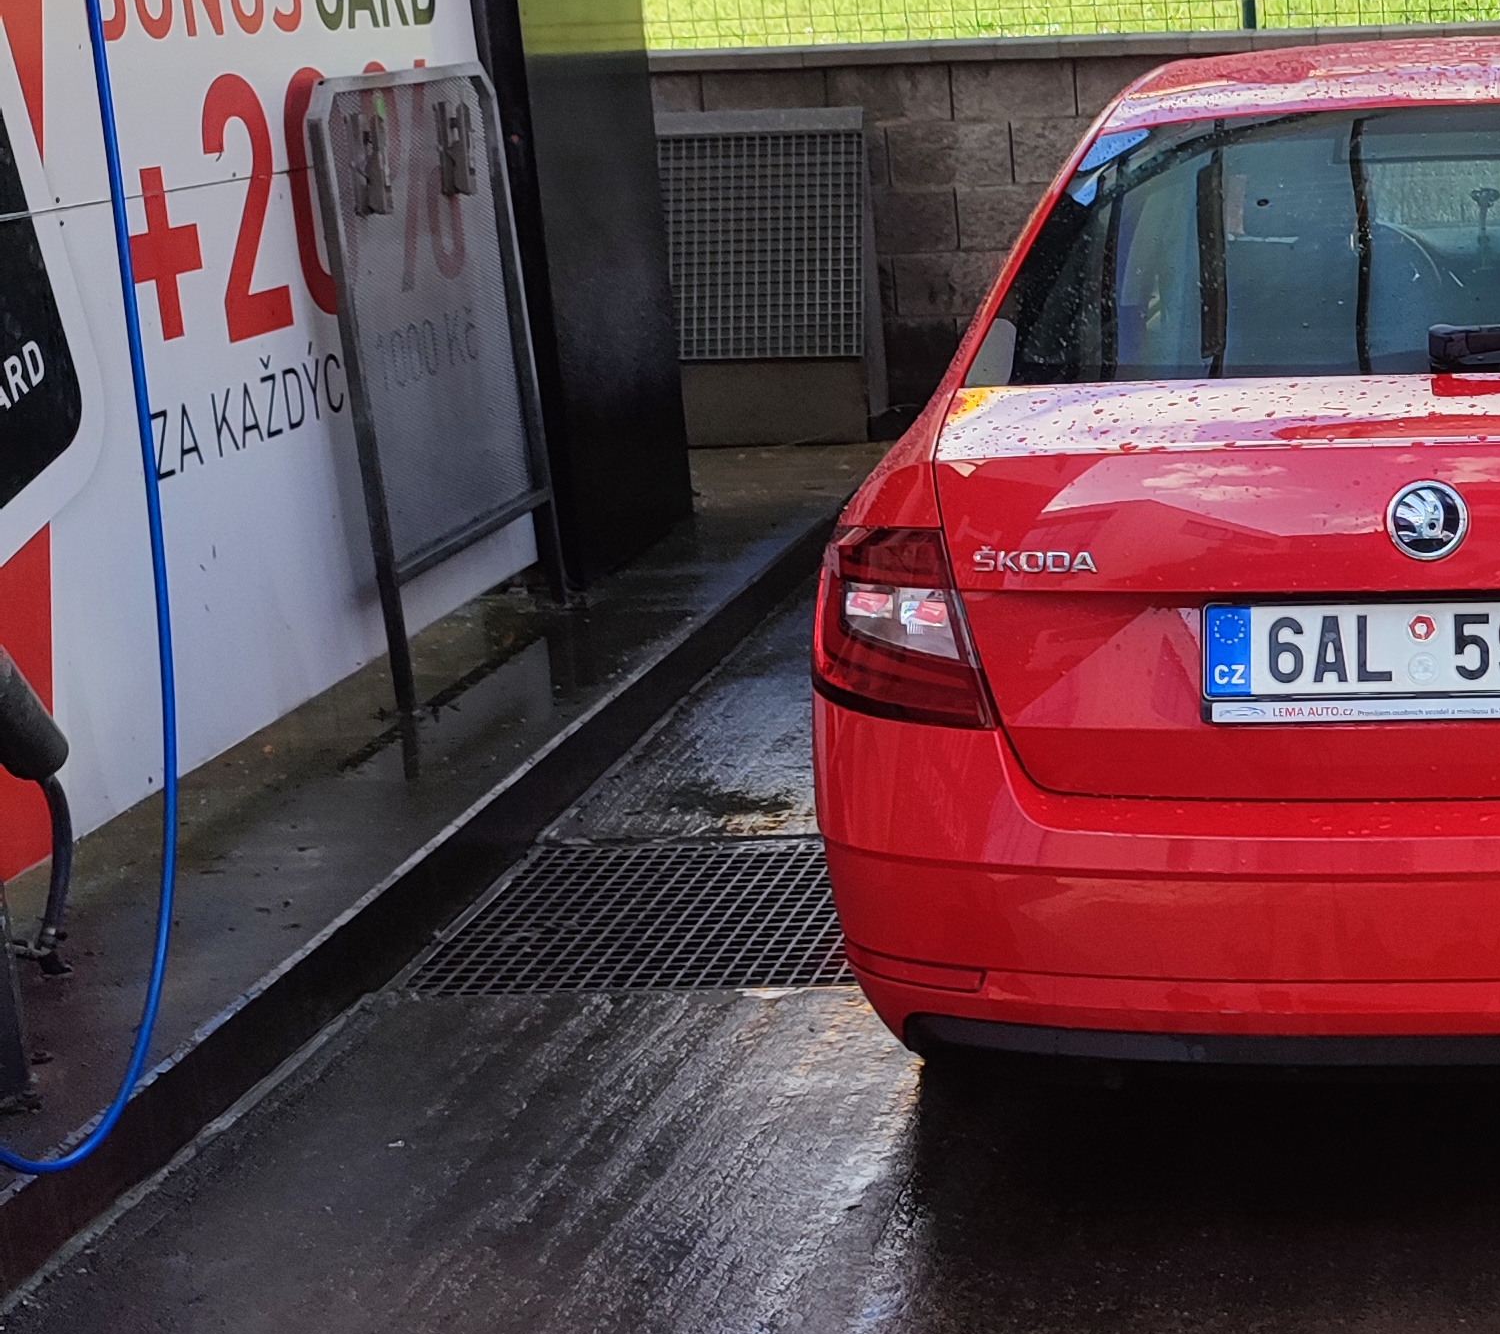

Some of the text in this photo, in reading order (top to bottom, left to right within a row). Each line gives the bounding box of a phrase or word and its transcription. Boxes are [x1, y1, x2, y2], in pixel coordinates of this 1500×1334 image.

[150, 403, 204, 481] ZA
[211, 341, 344, 458] KAŽDÝC
[973, 545, 1098, 573] ŠKODA
[1269, 615, 1393, 684] 6AL
[1214, 664, 1246, 684] CZ
[1272, 706, 1305, 717] LEMA
